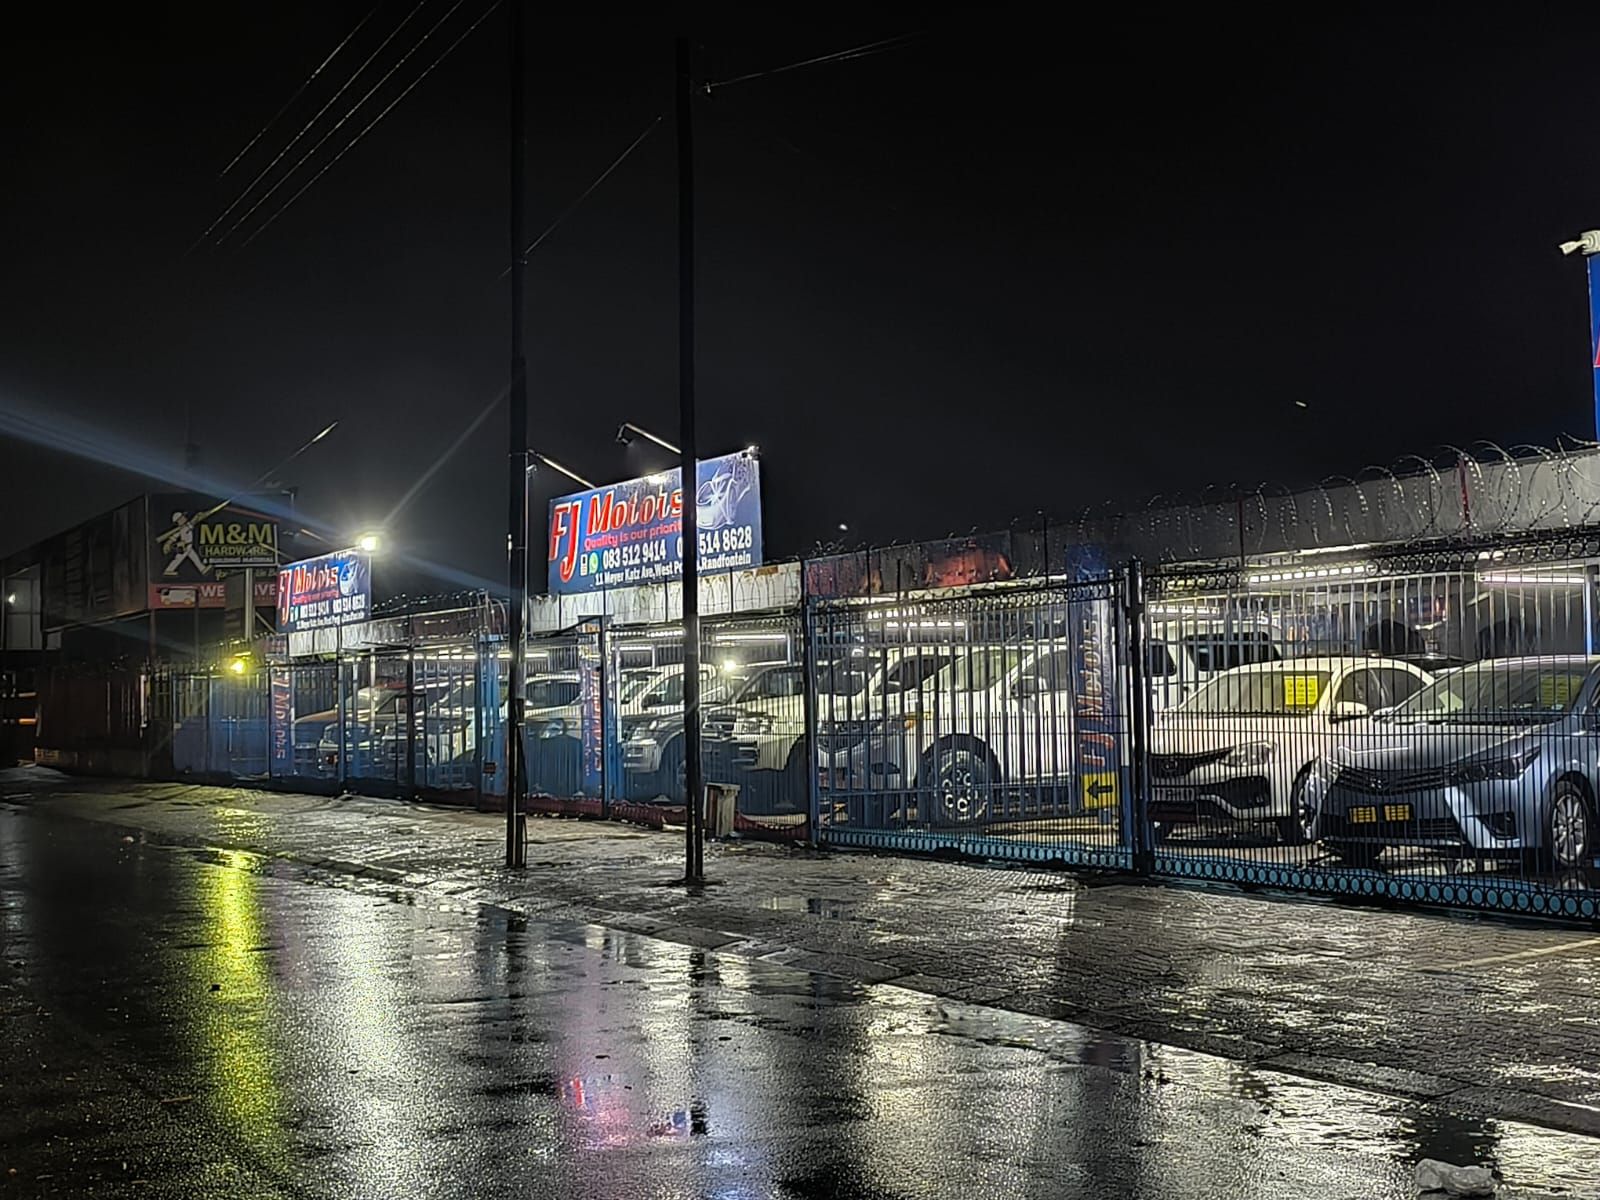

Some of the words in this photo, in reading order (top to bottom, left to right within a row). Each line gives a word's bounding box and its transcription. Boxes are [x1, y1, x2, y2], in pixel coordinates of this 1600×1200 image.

[200, 523, 273, 545] M&M
[548, 500, 582, 583] FJ
[586, 486, 683, 536] Motors
[584, 534, 618, 552] Quality
[631, 529, 647, 540] our
[650, 519, 683, 539] priorit
[699, 531, 720, 555] 514
[722, 525, 752, 551] 8628
[205, 545, 268, 557] HARDWARE
[603, 547, 620, 570] 083
[622, 544, 641, 566] 512
[642, 539, 667, 563] 9414
[201, 585, 225, 598] WE
